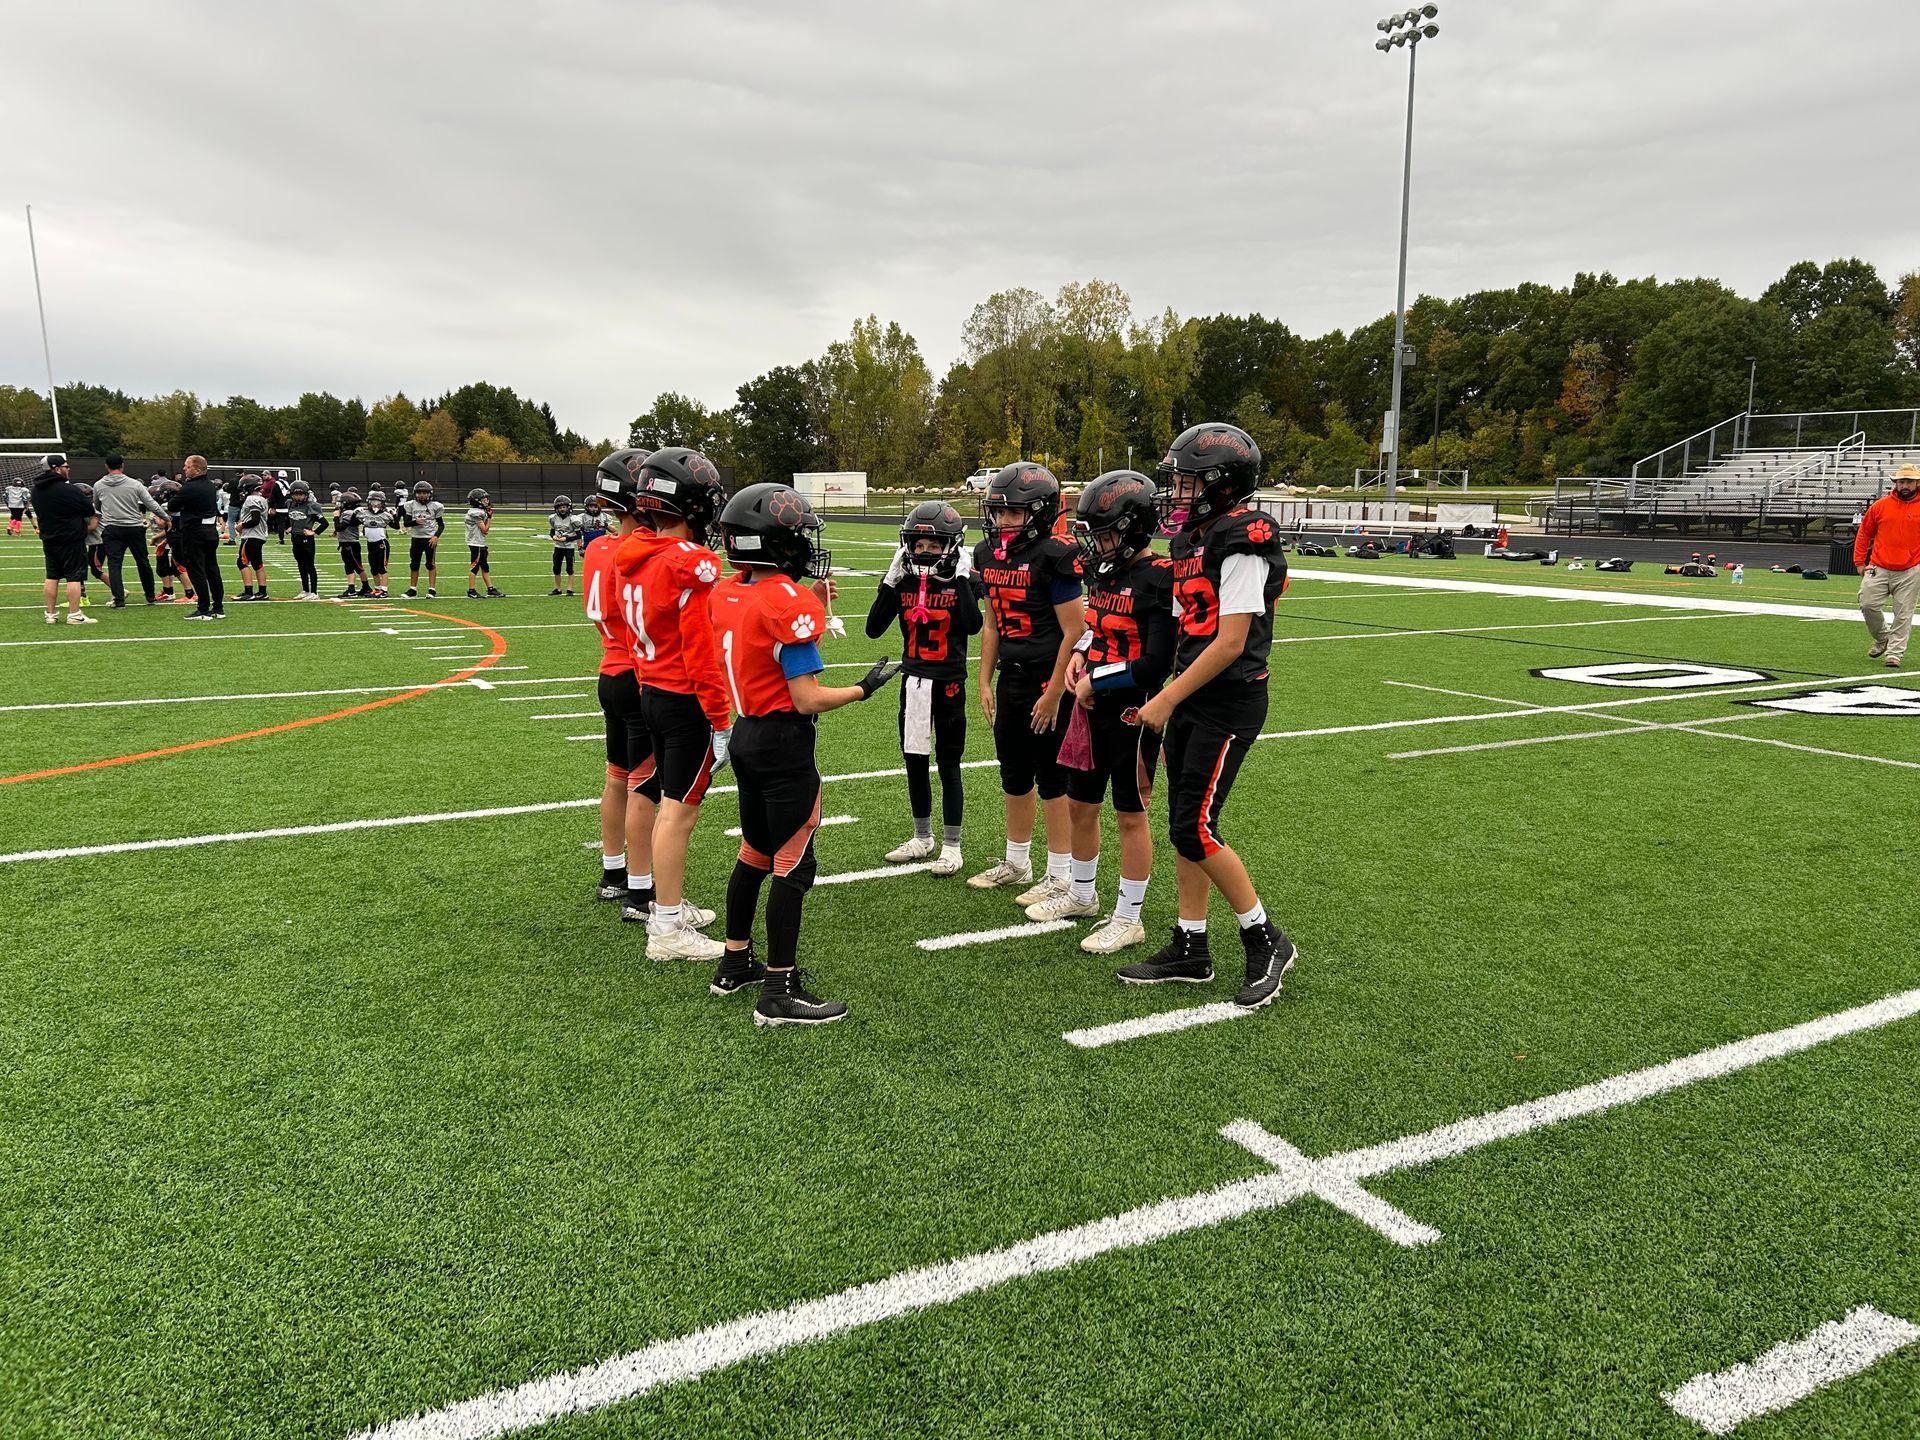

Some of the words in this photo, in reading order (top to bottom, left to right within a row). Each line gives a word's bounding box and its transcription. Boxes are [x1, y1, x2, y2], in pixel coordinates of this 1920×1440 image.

[900, 592, 958, 608] BRIHTON
[983, 568, 1031, 587] BRIGHTON
[586, 569, 615, 639] 4
[622, 583, 656, 661] 11
[988, 586, 1033, 638] 15
[903, 609, 951, 661] 13
[722, 629, 746, 718] 1
